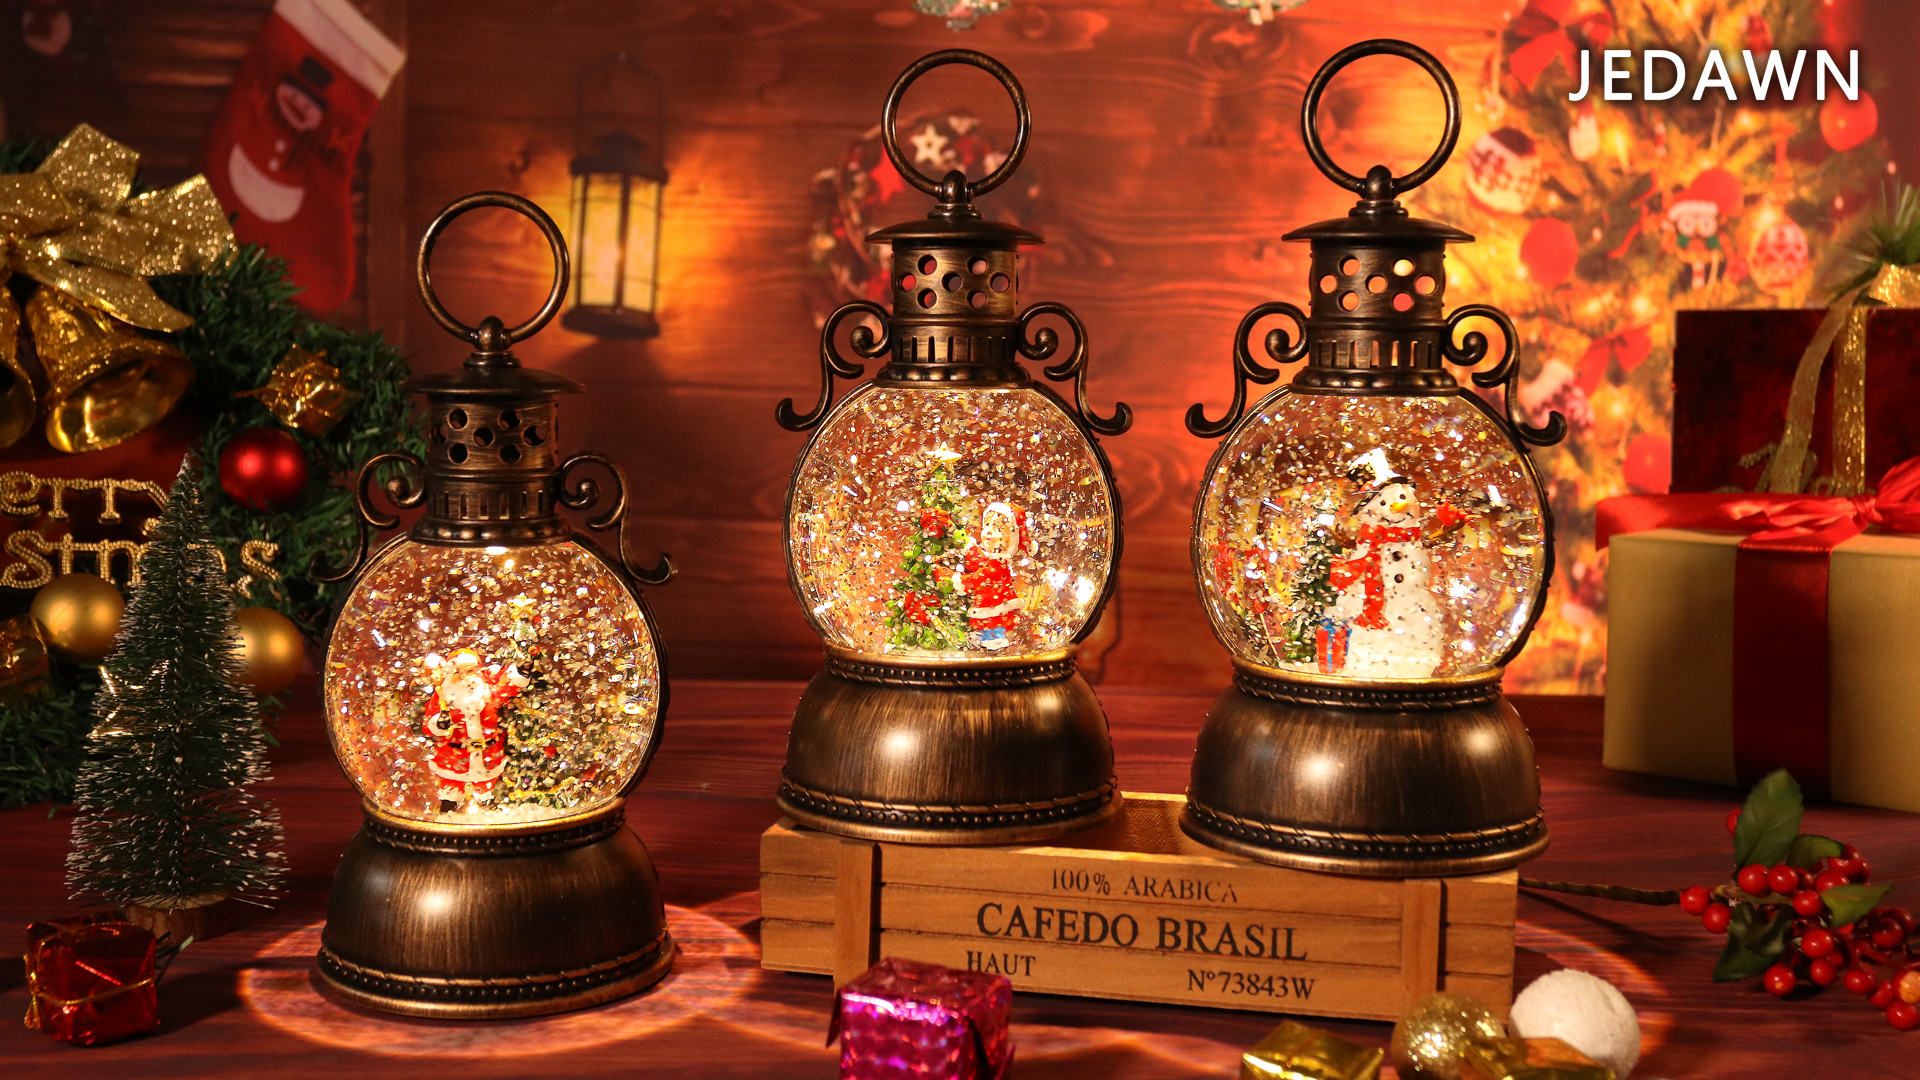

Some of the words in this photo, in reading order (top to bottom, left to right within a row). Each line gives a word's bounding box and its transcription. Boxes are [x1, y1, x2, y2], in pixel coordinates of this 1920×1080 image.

[1052, 868, 1110, 895] 100%
[1124, 876, 1238, 902] ARABICA
[977, 902, 1139, 947] CAFEDO
[1157, 917, 1308, 961] BRASIL
[966, 950, 1036, 977] HAUT
